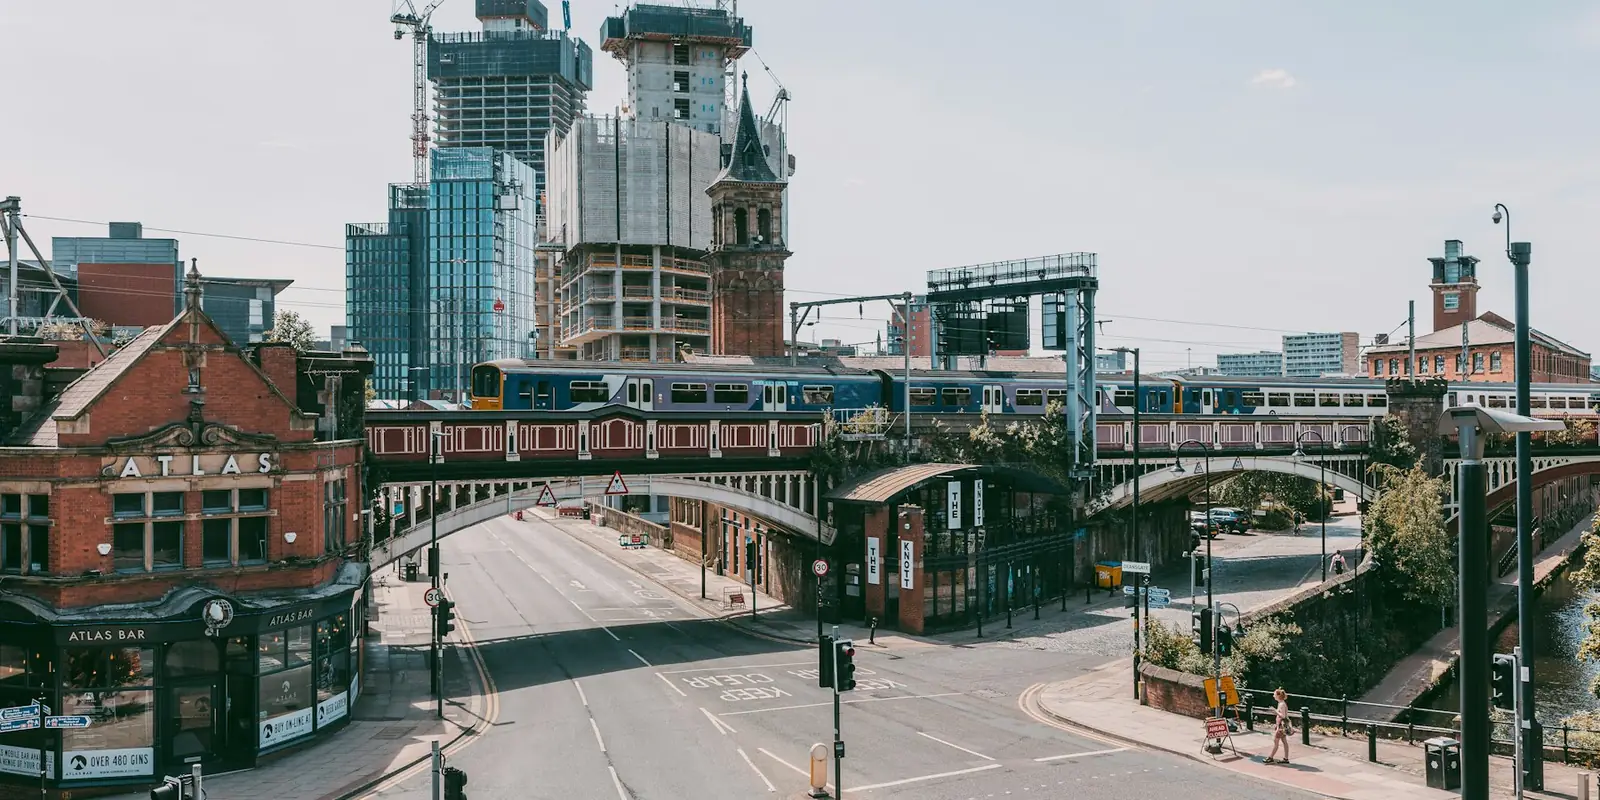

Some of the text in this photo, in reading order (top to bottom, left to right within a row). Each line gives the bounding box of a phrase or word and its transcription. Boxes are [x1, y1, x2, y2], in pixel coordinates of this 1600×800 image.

[120, 453, 271, 478] ATLAS
[428, 593, 440, 601] 30
[270, 609, 313, 626] ATLAS BAR
[69, 629, 146, 641] ATLAS BAR
[682, 673, 774, 688] CLEAR
[720, 686, 792, 702] KEEP
[274, 722, 285, 734] BUY
[285, 715, 304, 730] ON-LINE
[305, 713, 311, 724] AT
[1209, 730, 1228, 738] CLOSED
[91, 753, 149, 768] OVER 480 GINS
